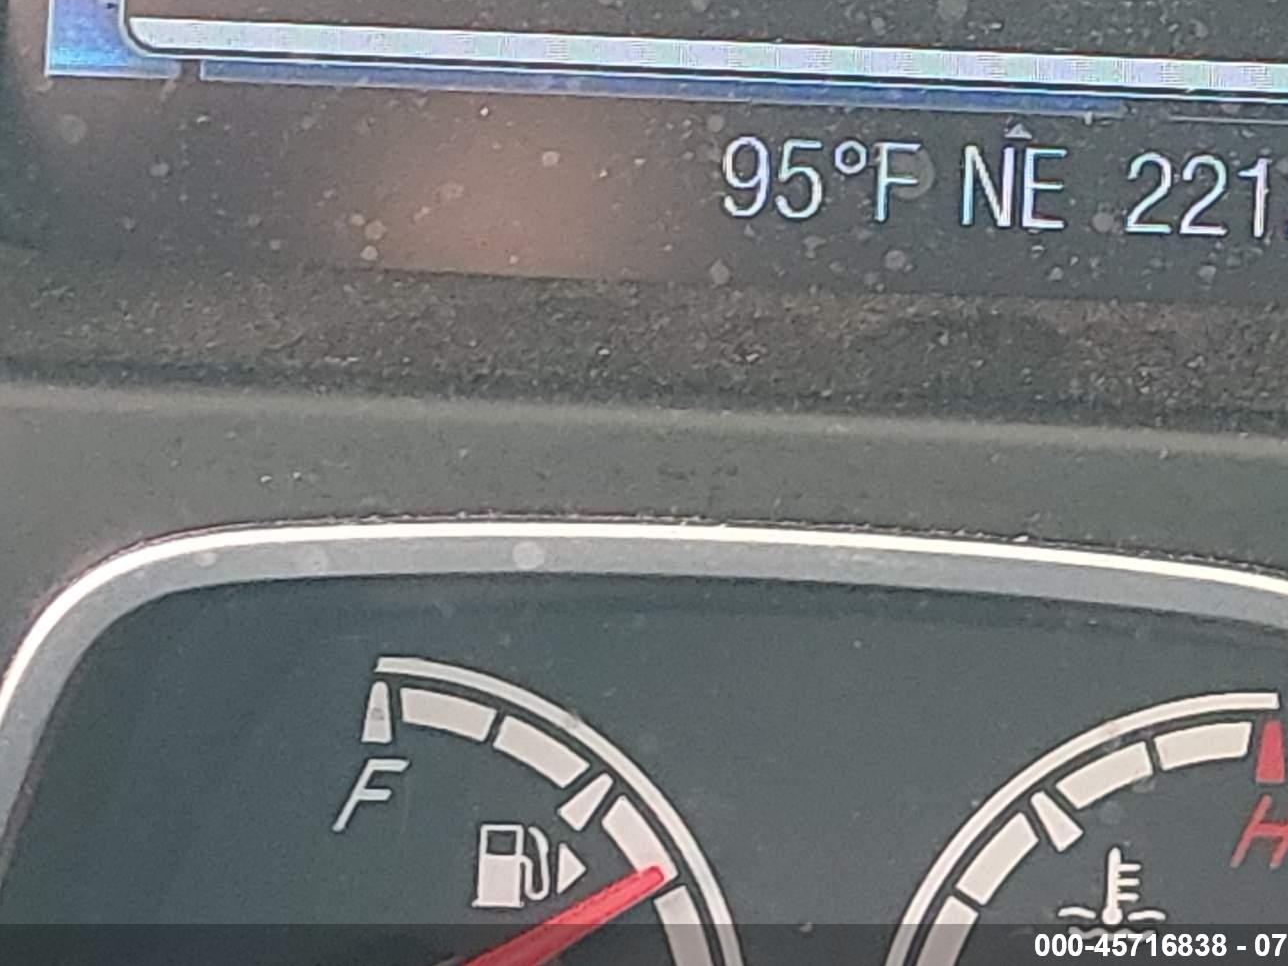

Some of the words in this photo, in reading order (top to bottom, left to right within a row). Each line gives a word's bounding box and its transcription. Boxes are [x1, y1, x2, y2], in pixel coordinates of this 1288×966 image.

[722, 136, 921, 224] 95°F
[961, 144, 1068, 231] NE
[332, 758, 409, 832] F
